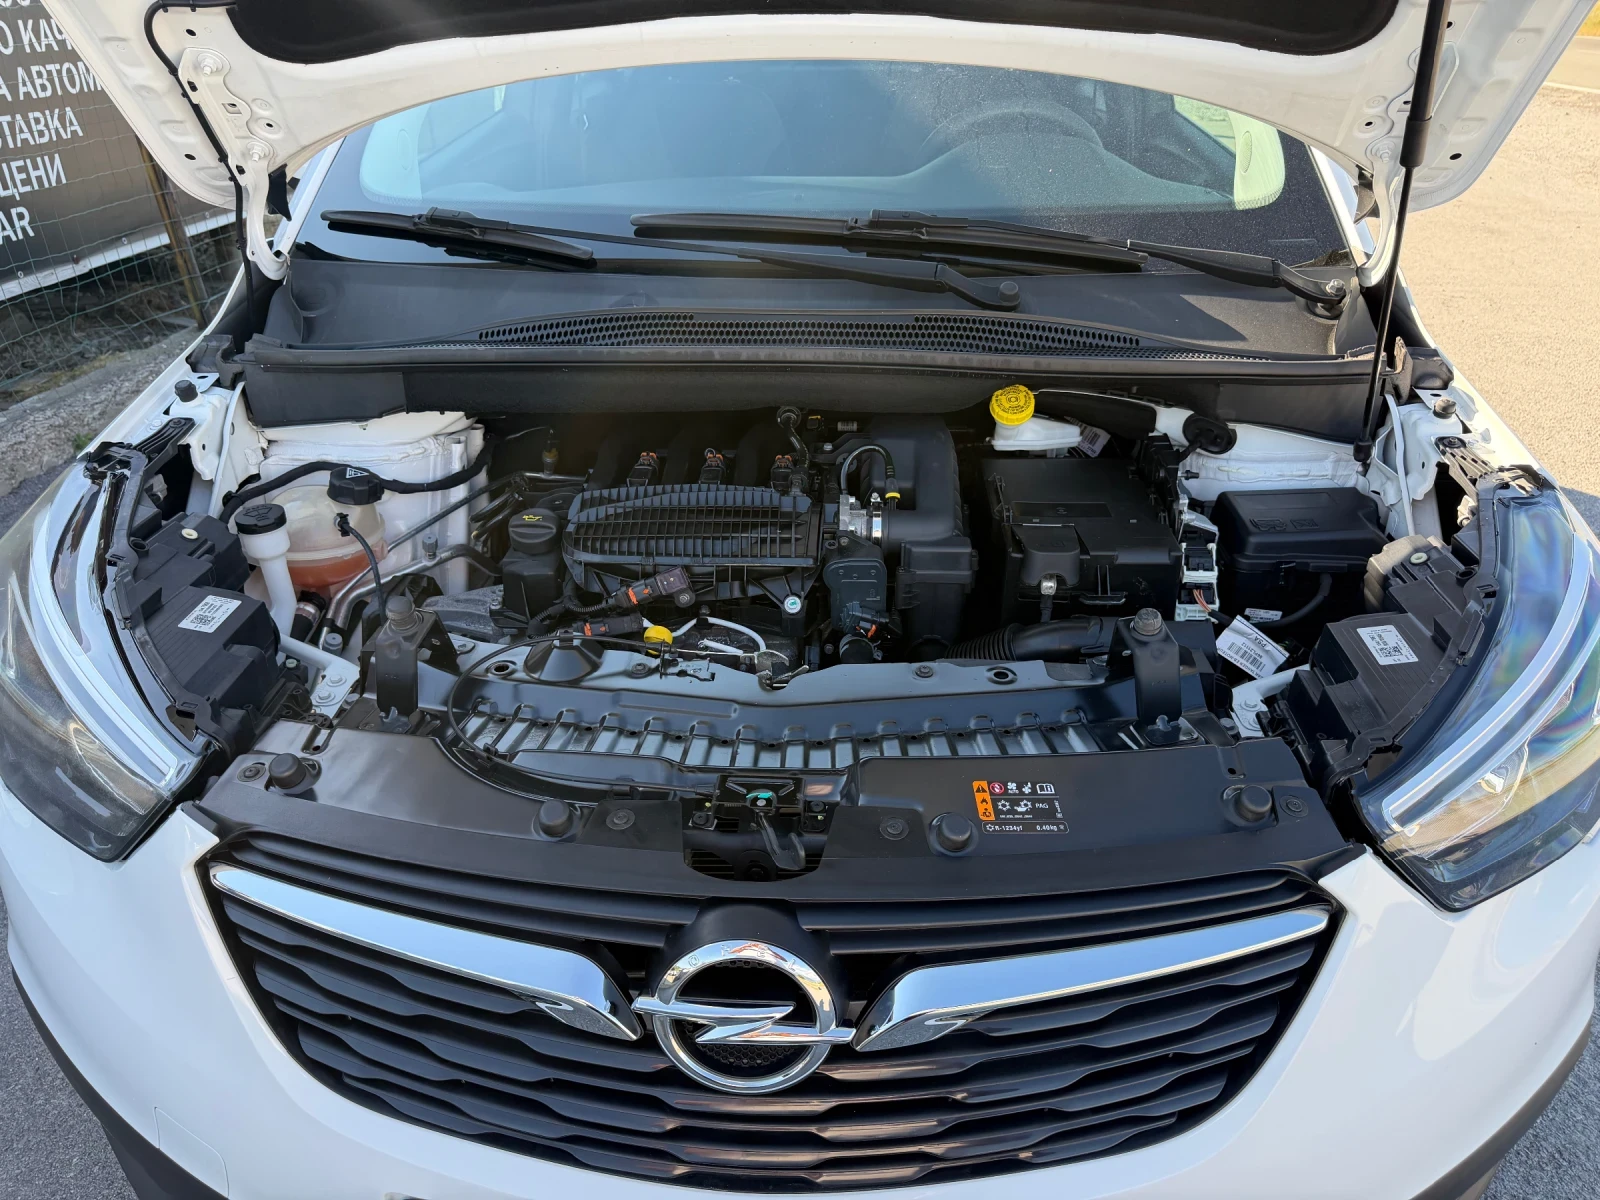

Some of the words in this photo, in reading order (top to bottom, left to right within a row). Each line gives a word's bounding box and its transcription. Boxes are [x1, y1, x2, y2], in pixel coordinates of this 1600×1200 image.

[17, 61, 102, 101] АВТОМ
[0, 106, 84, 149] ТАВКА
[1254, 635, 1267, 648] PSA
